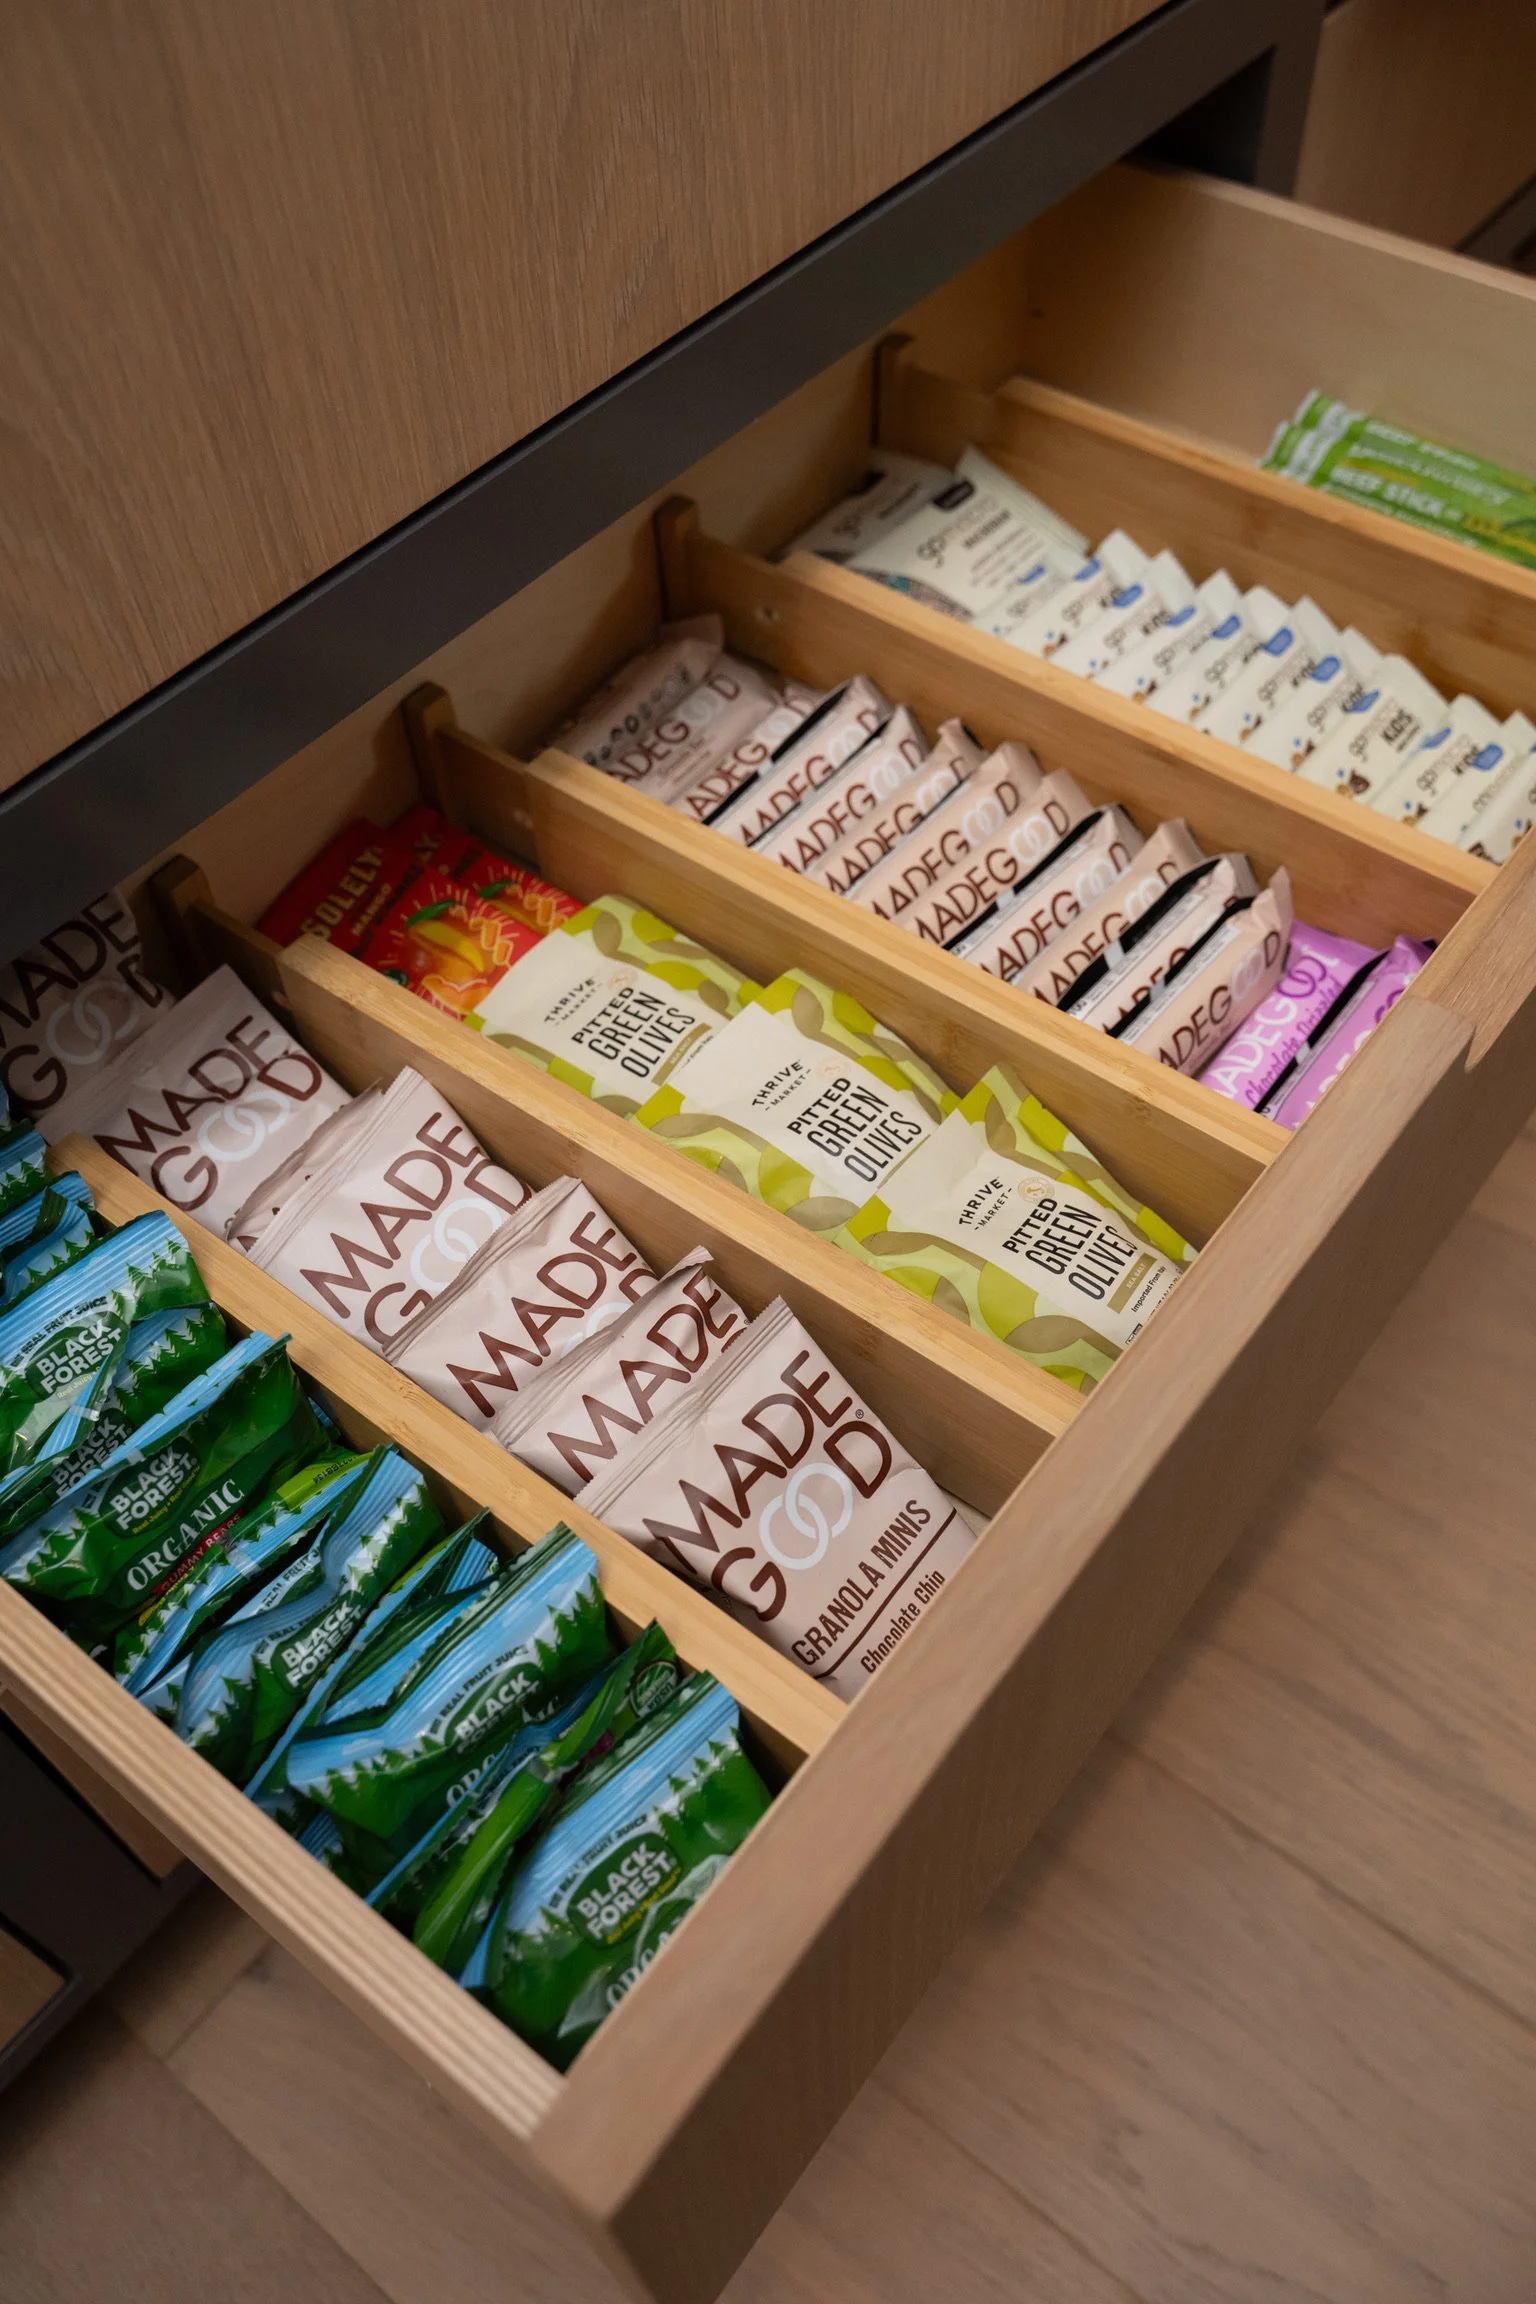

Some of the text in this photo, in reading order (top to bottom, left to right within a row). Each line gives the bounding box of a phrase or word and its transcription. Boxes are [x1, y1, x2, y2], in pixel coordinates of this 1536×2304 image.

[301, 847, 383, 942] SOLELY
[544, 977, 596, 1023] THRIVE
[571, 987, 635, 1045] PITTED
[588, 991, 667, 1060] GREEN
[1158, 930, 1282, 1071] ADEGOOD
[620, 1007, 696, 1078] OLIVES
[93, 1015, 271, 1177] MADE
[752, 1060, 804, 1107] THRIVE
[771, 1074, 807, 1107] MARKET
[786, 1077, 852, 1135] PITTED
[151, 1053, 323, 1212] GOOD
[807, 1085, 890, 1157] GREEN
[844, 1111, 922, 1182] OLIVES
[300, 1111, 482, 1319] MADE
[958, 1177, 1004, 1227] THRIVE
[978, 1193, 1009, 1227] MARKET
[1001, 1198, 1058, 1254] PITTED
[364, 1158, 532, 1346] GOOD
[1025, 1204, 1103, 1275] GREEN
[1068, 1225, 1138, 1300] OLIVES
[446, 1211, 637, 1418] MADE
[1131, 1278, 1153, 1313] Imported
[36, 1319, 112, 1376] BLACK
[40, 1329, 122, 1394] FOREST
[547, 1270, 739, 1483] MADE
[51, 1416, 119, 1485] BLACK
[110, 1446, 185, 1513] BLACK
[642, 1350, 852, 1575] MADE
[116, 1452, 193, 1531] FOREST
[711, 1419, 892, 1622] GOOD
[127, 1479, 246, 1592] ORGANIC
[161, 1513, 242, 1593] GUMMY BEARS
[791, 1499, 931, 1666] GRANOLA MINIS
[281, 1599, 354, 1669] BLACK
[286, 1606, 364, 1688] FOREST
[860, 1602, 921, 1674] Chocolate
[438, 1689, 465, 1719] REAL
[461, 1664, 496, 1692] FRUIT
[454, 1671, 535, 1740] BLACK
[577, 1842, 656, 1918] BLACK
[587, 1851, 672, 1939] FOREST
